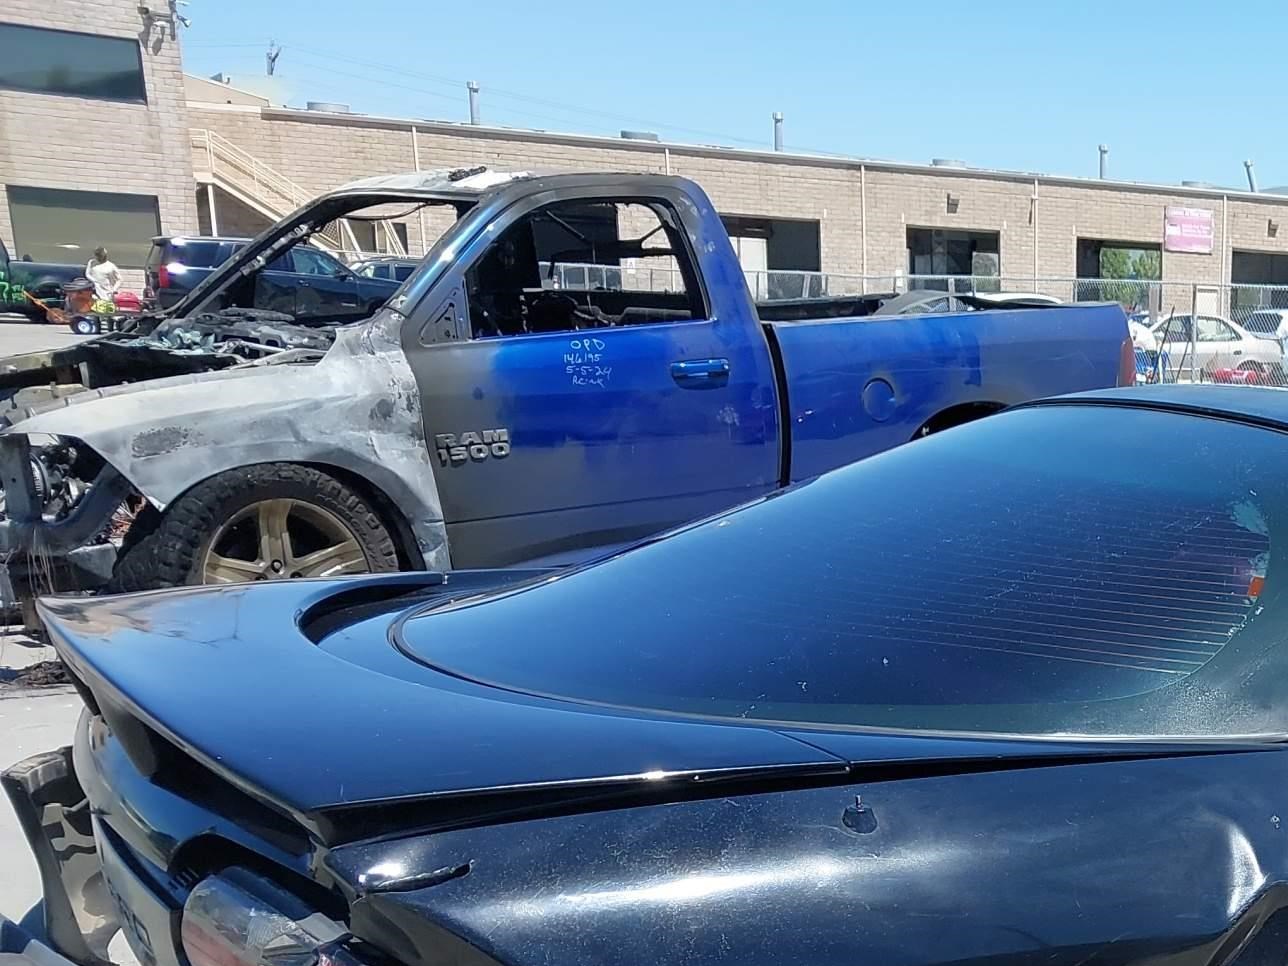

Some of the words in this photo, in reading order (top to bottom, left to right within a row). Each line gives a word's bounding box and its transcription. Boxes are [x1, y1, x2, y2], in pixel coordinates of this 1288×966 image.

[570, 338, 606, 351] OPD
[565, 365, 613, 380] 5-5-24
[435, 428, 509, 448] RAM
[437, 442, 511, 464] 1500
